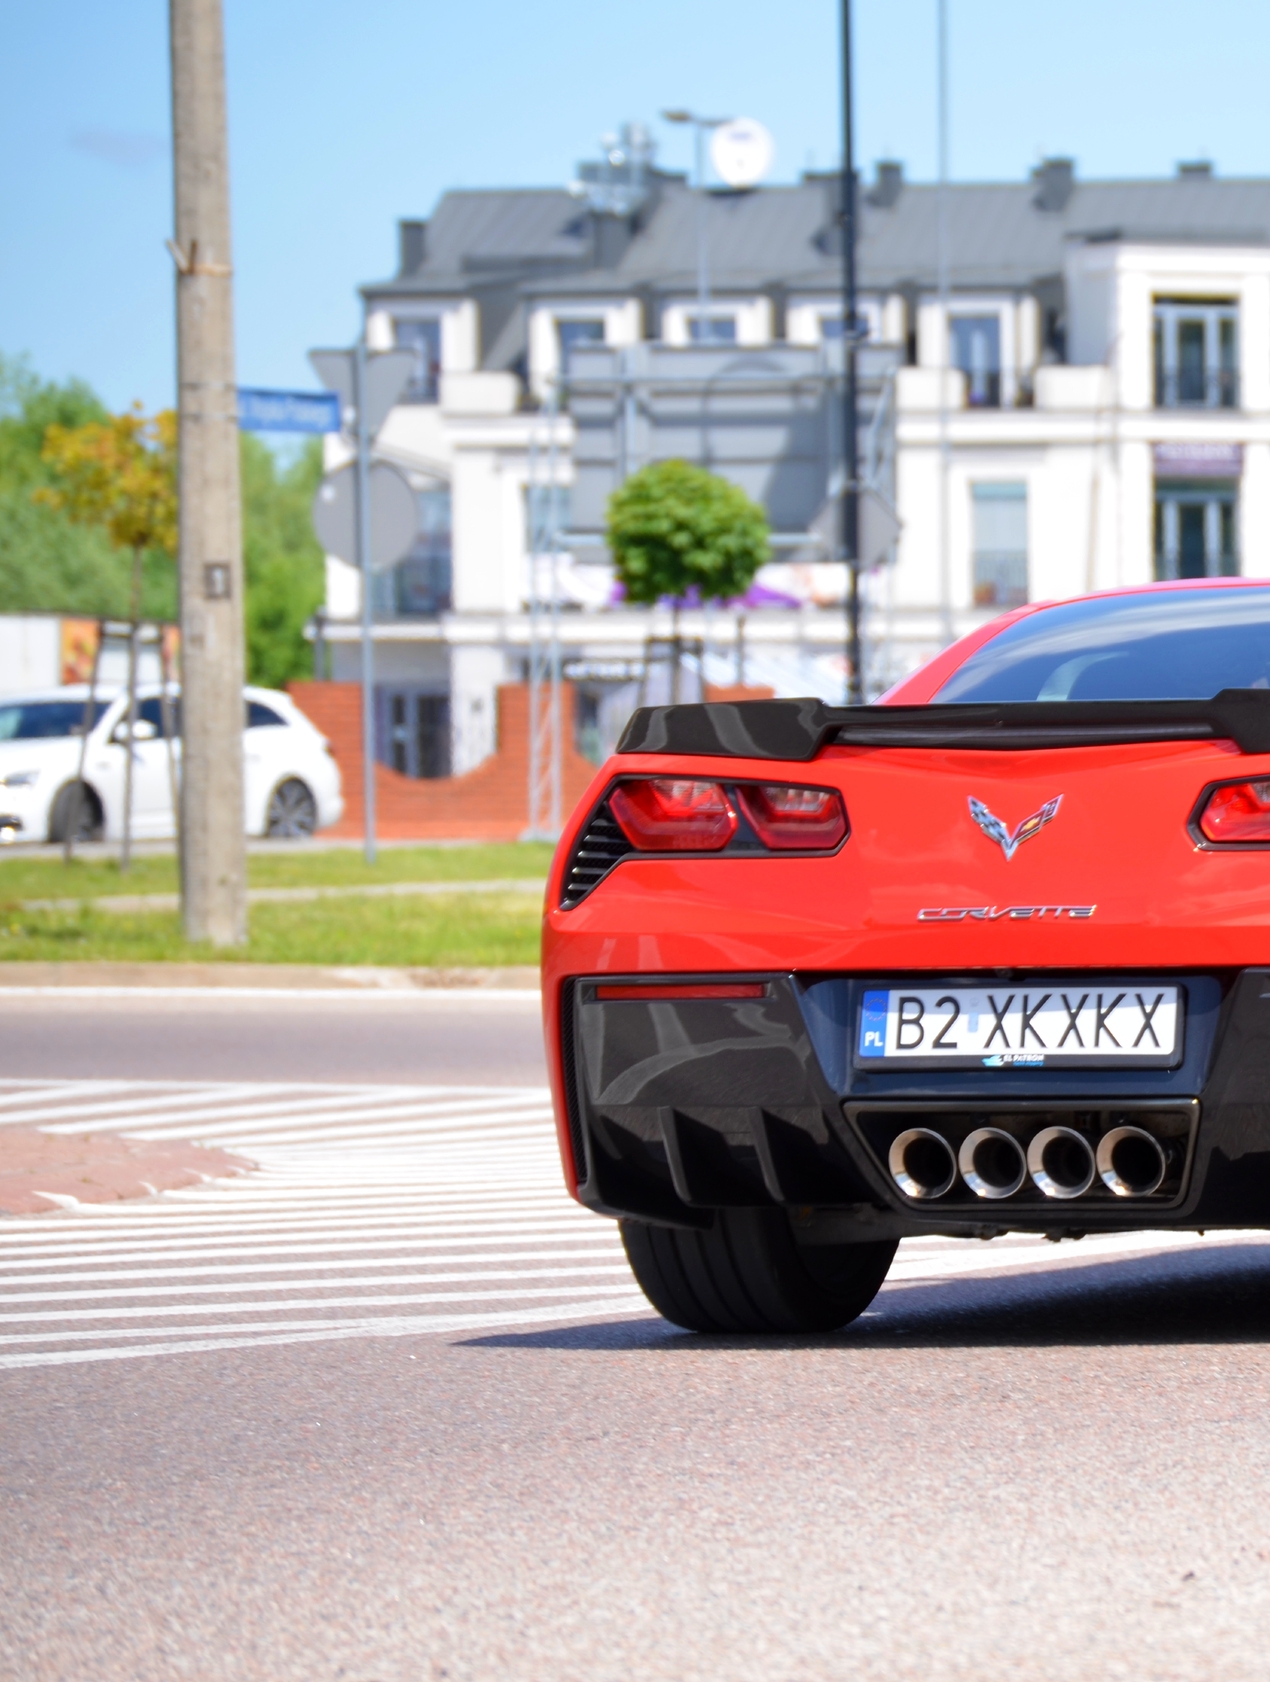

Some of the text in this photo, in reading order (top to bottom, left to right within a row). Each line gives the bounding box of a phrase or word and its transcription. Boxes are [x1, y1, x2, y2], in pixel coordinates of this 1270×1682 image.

[917, 904, 1097, 921] CORVETTE
[896, 993, 1165, 1050] B2 XKXKX
[864, 1031, 884, 1047] PL
